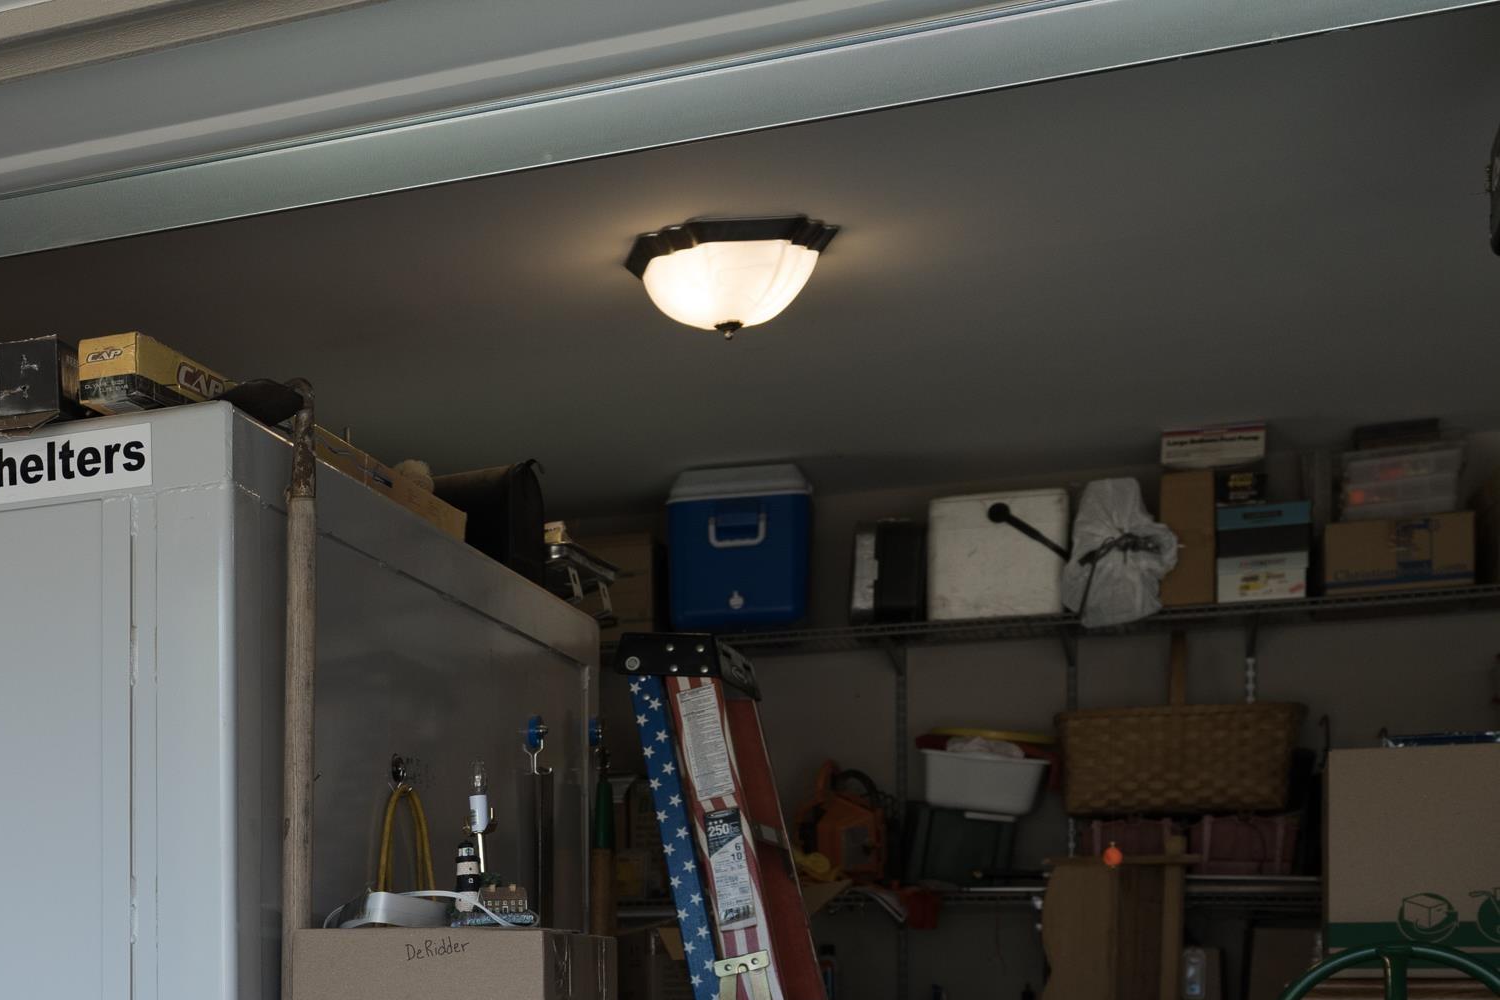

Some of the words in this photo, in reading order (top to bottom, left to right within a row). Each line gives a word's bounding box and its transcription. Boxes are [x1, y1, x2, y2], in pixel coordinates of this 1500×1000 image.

[88, 349, 122, 363] CAP
[178, 364, 224, 399] CAP
[707, 823, 730, 838] 250
[405, 937, 470, 961] DeRidder
